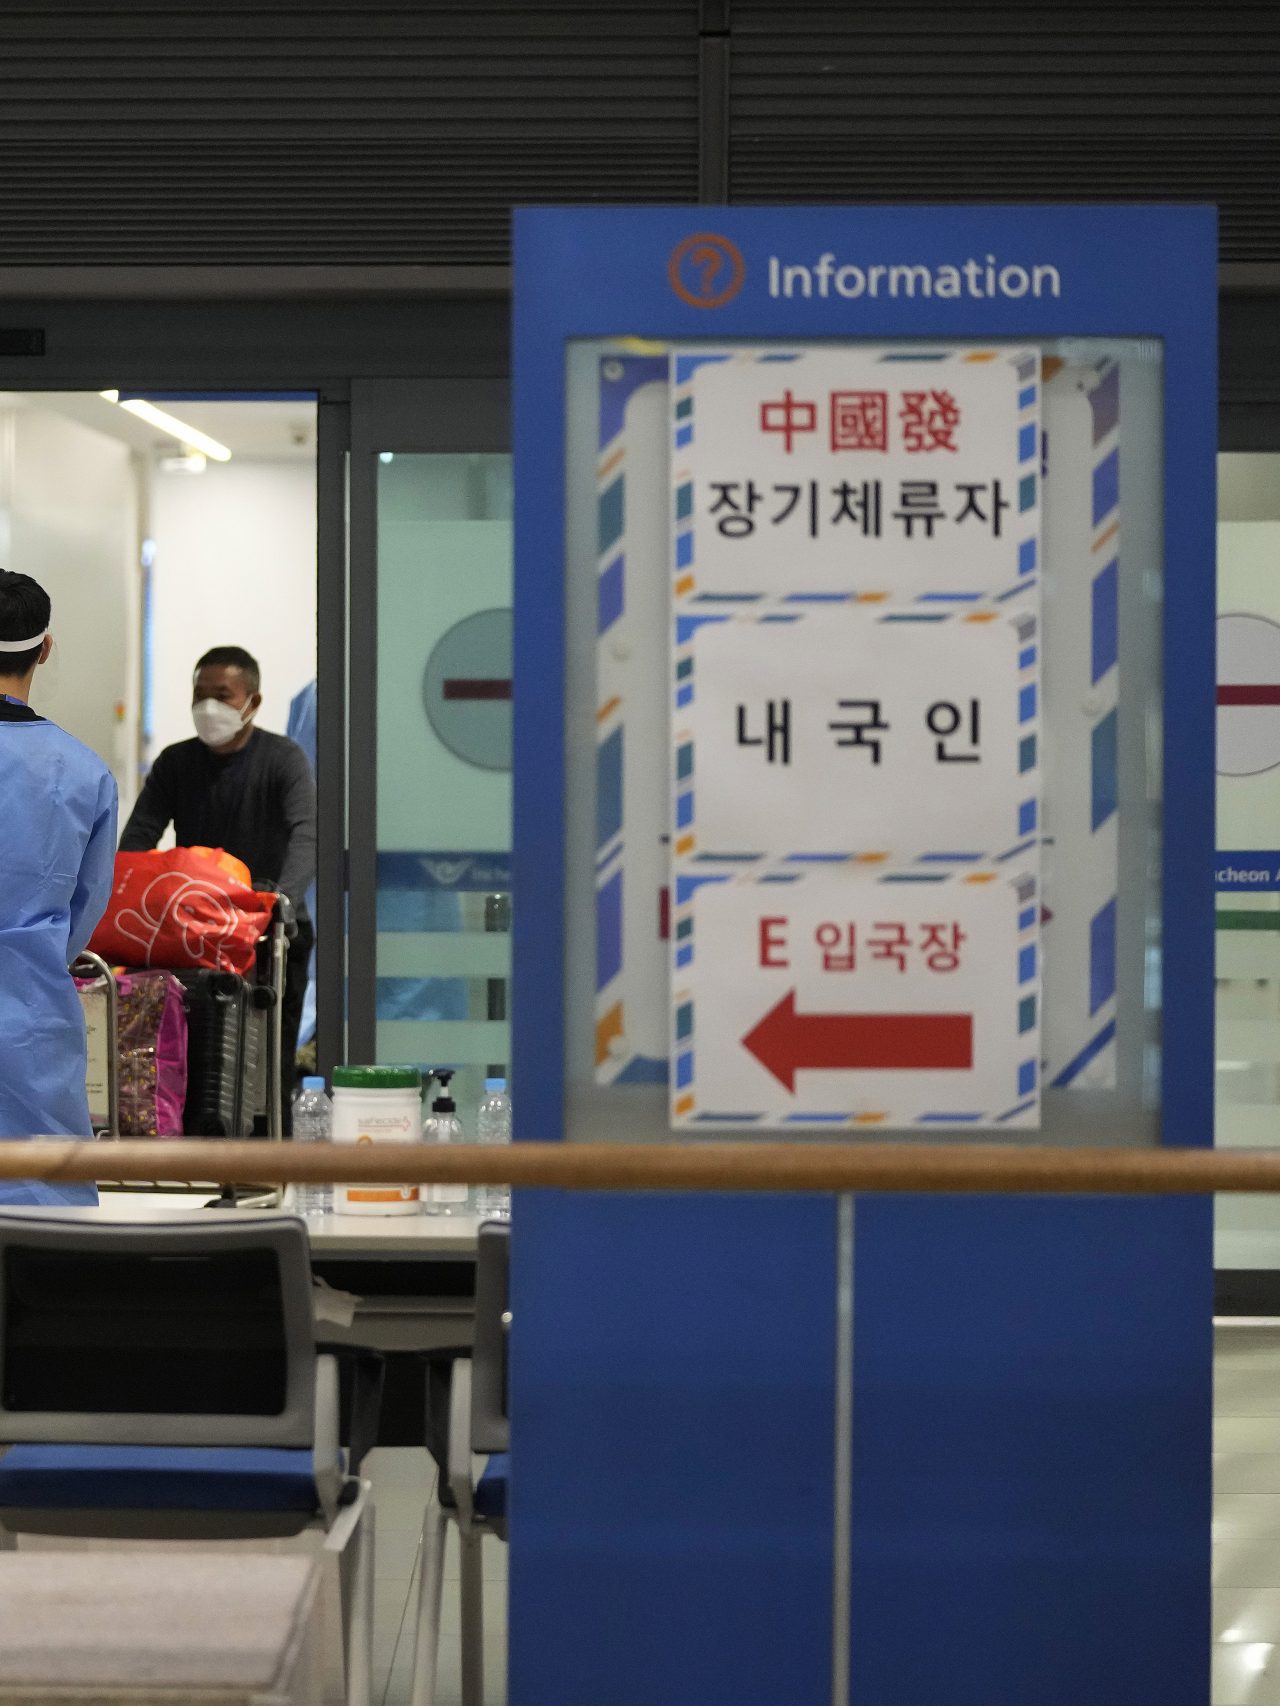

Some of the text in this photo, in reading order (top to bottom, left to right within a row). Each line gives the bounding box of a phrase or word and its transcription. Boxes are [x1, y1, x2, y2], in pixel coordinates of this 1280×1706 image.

[769, 253, 1060, 298] Information
[760, 389, 960, 455] 中國發
[708, 478, 1011, 540] 장기체류자
[759, 917, 966, 972] E 입국장
